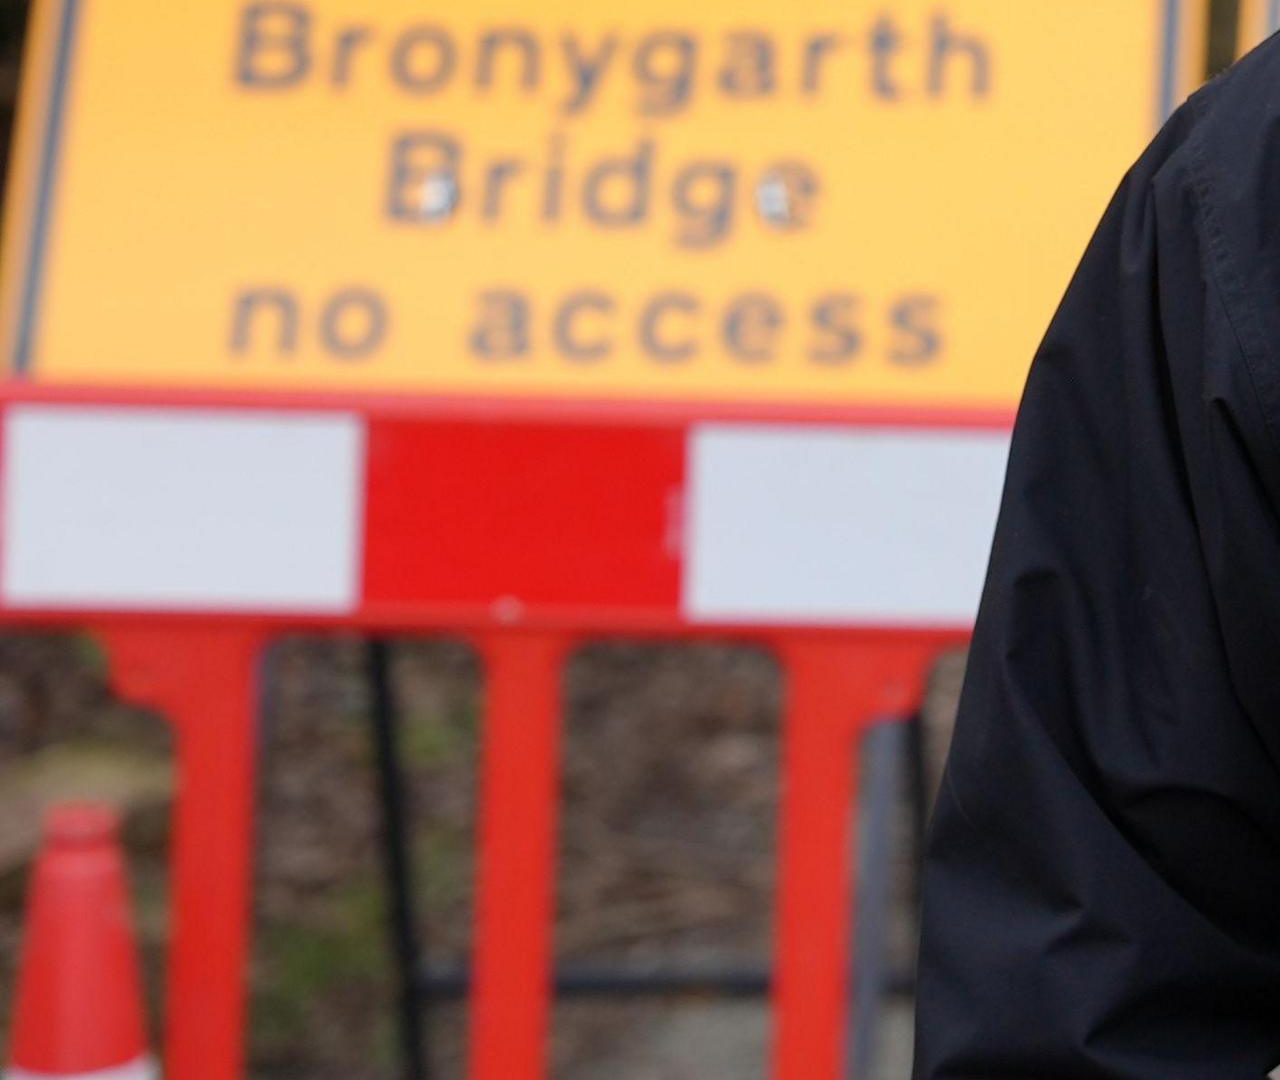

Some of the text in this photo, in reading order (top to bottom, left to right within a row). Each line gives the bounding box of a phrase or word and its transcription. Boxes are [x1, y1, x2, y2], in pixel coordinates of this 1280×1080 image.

[232, 0, 990, 116] Bronygarth
[383, 132, 820, 248] Bridge
[229, 287, 944, 366] no access
